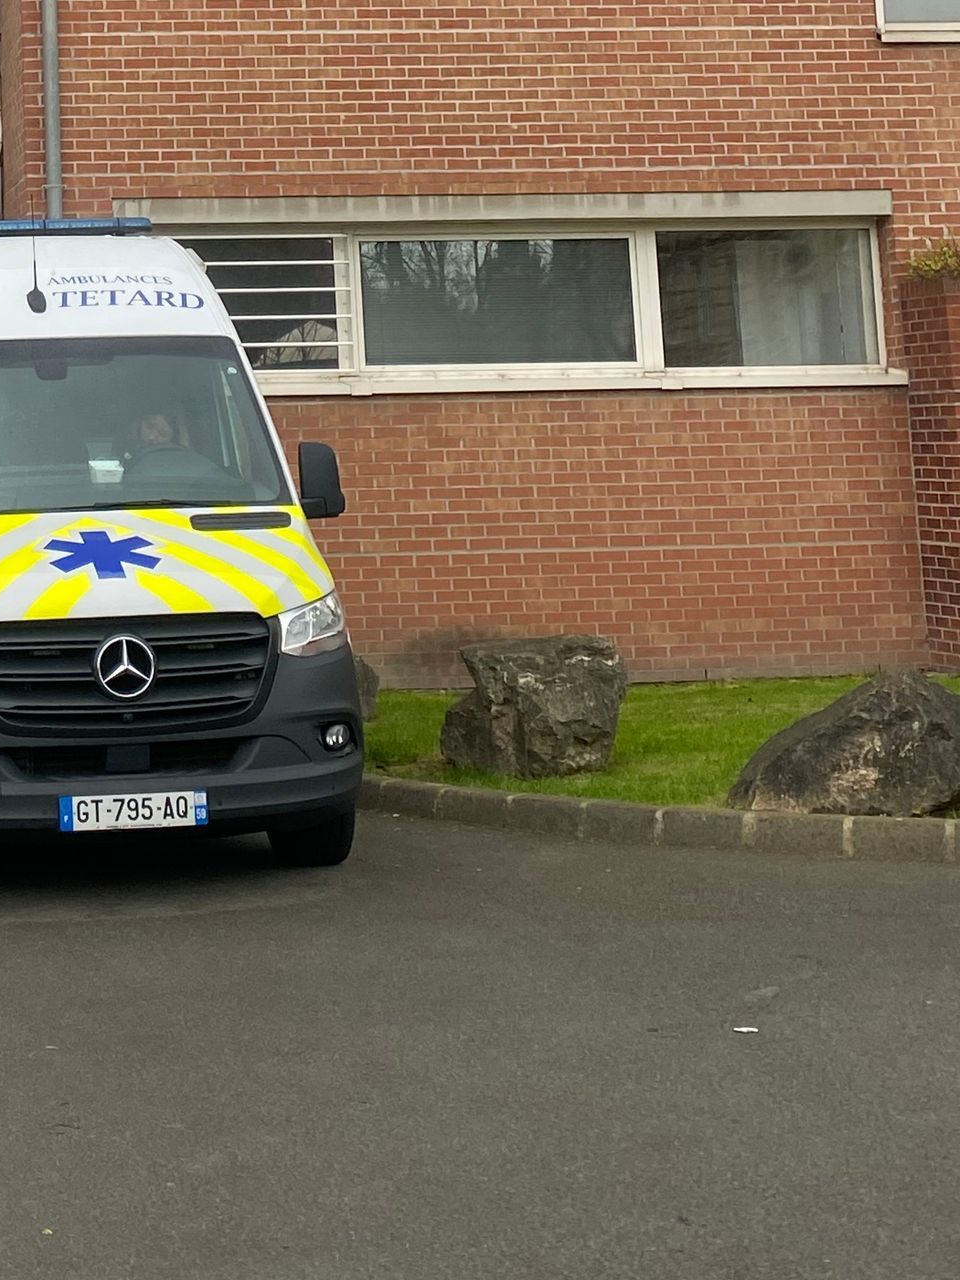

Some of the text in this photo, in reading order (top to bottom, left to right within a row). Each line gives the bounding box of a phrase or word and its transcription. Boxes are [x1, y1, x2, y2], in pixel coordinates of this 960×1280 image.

[48, 275, 173, 286] AMBULANCES
[52, 289, 205, 310] TETARD
[76, 795, 188, 823] GT-795-AQ
[196, 808, 207, 820] 59
